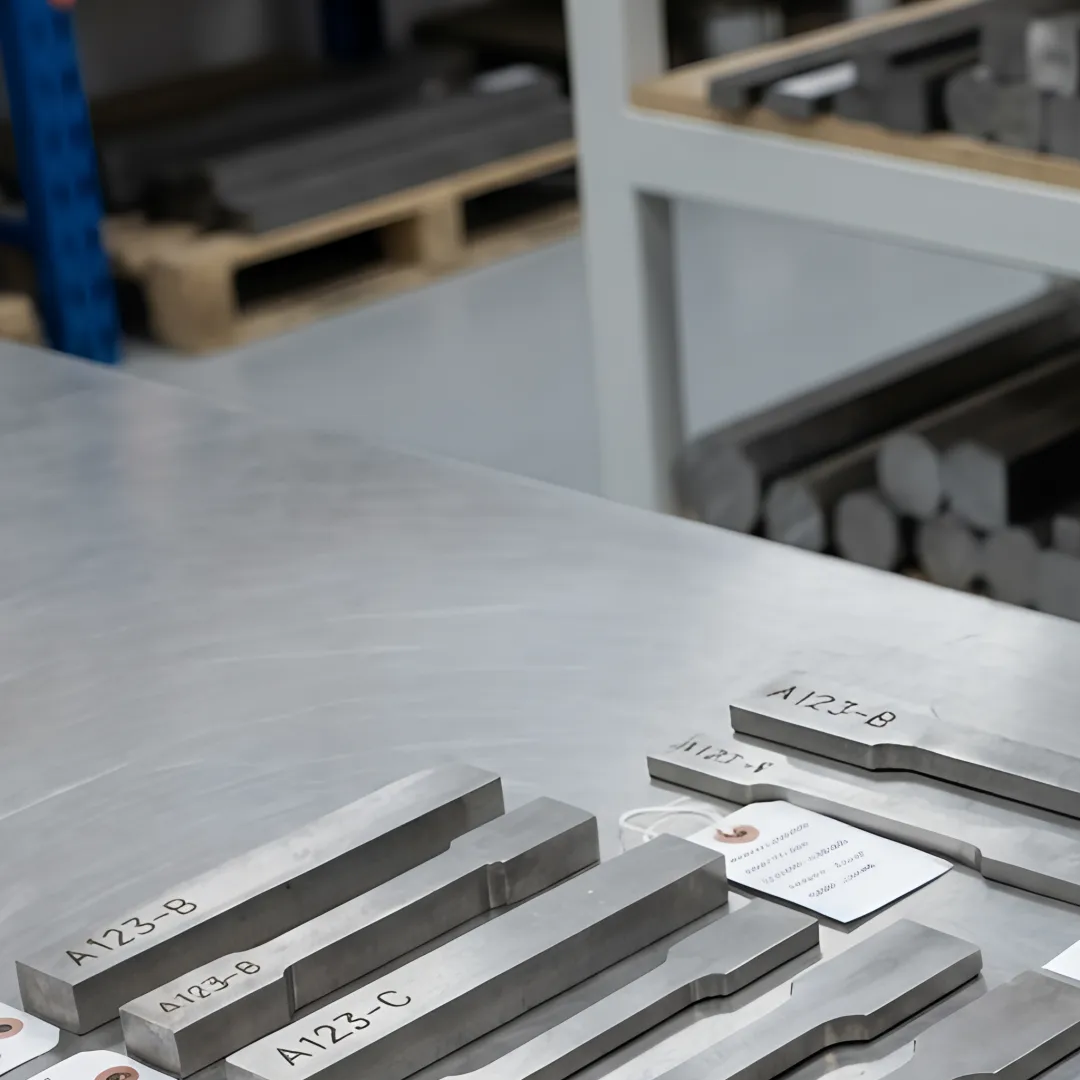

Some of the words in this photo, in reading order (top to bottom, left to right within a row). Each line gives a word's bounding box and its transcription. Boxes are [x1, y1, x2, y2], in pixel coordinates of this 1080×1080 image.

[766, 685, 897, 728] A123-B
[66, 898, 198, 966] A123-B
[276, 990, 412, 1066] A123-C
